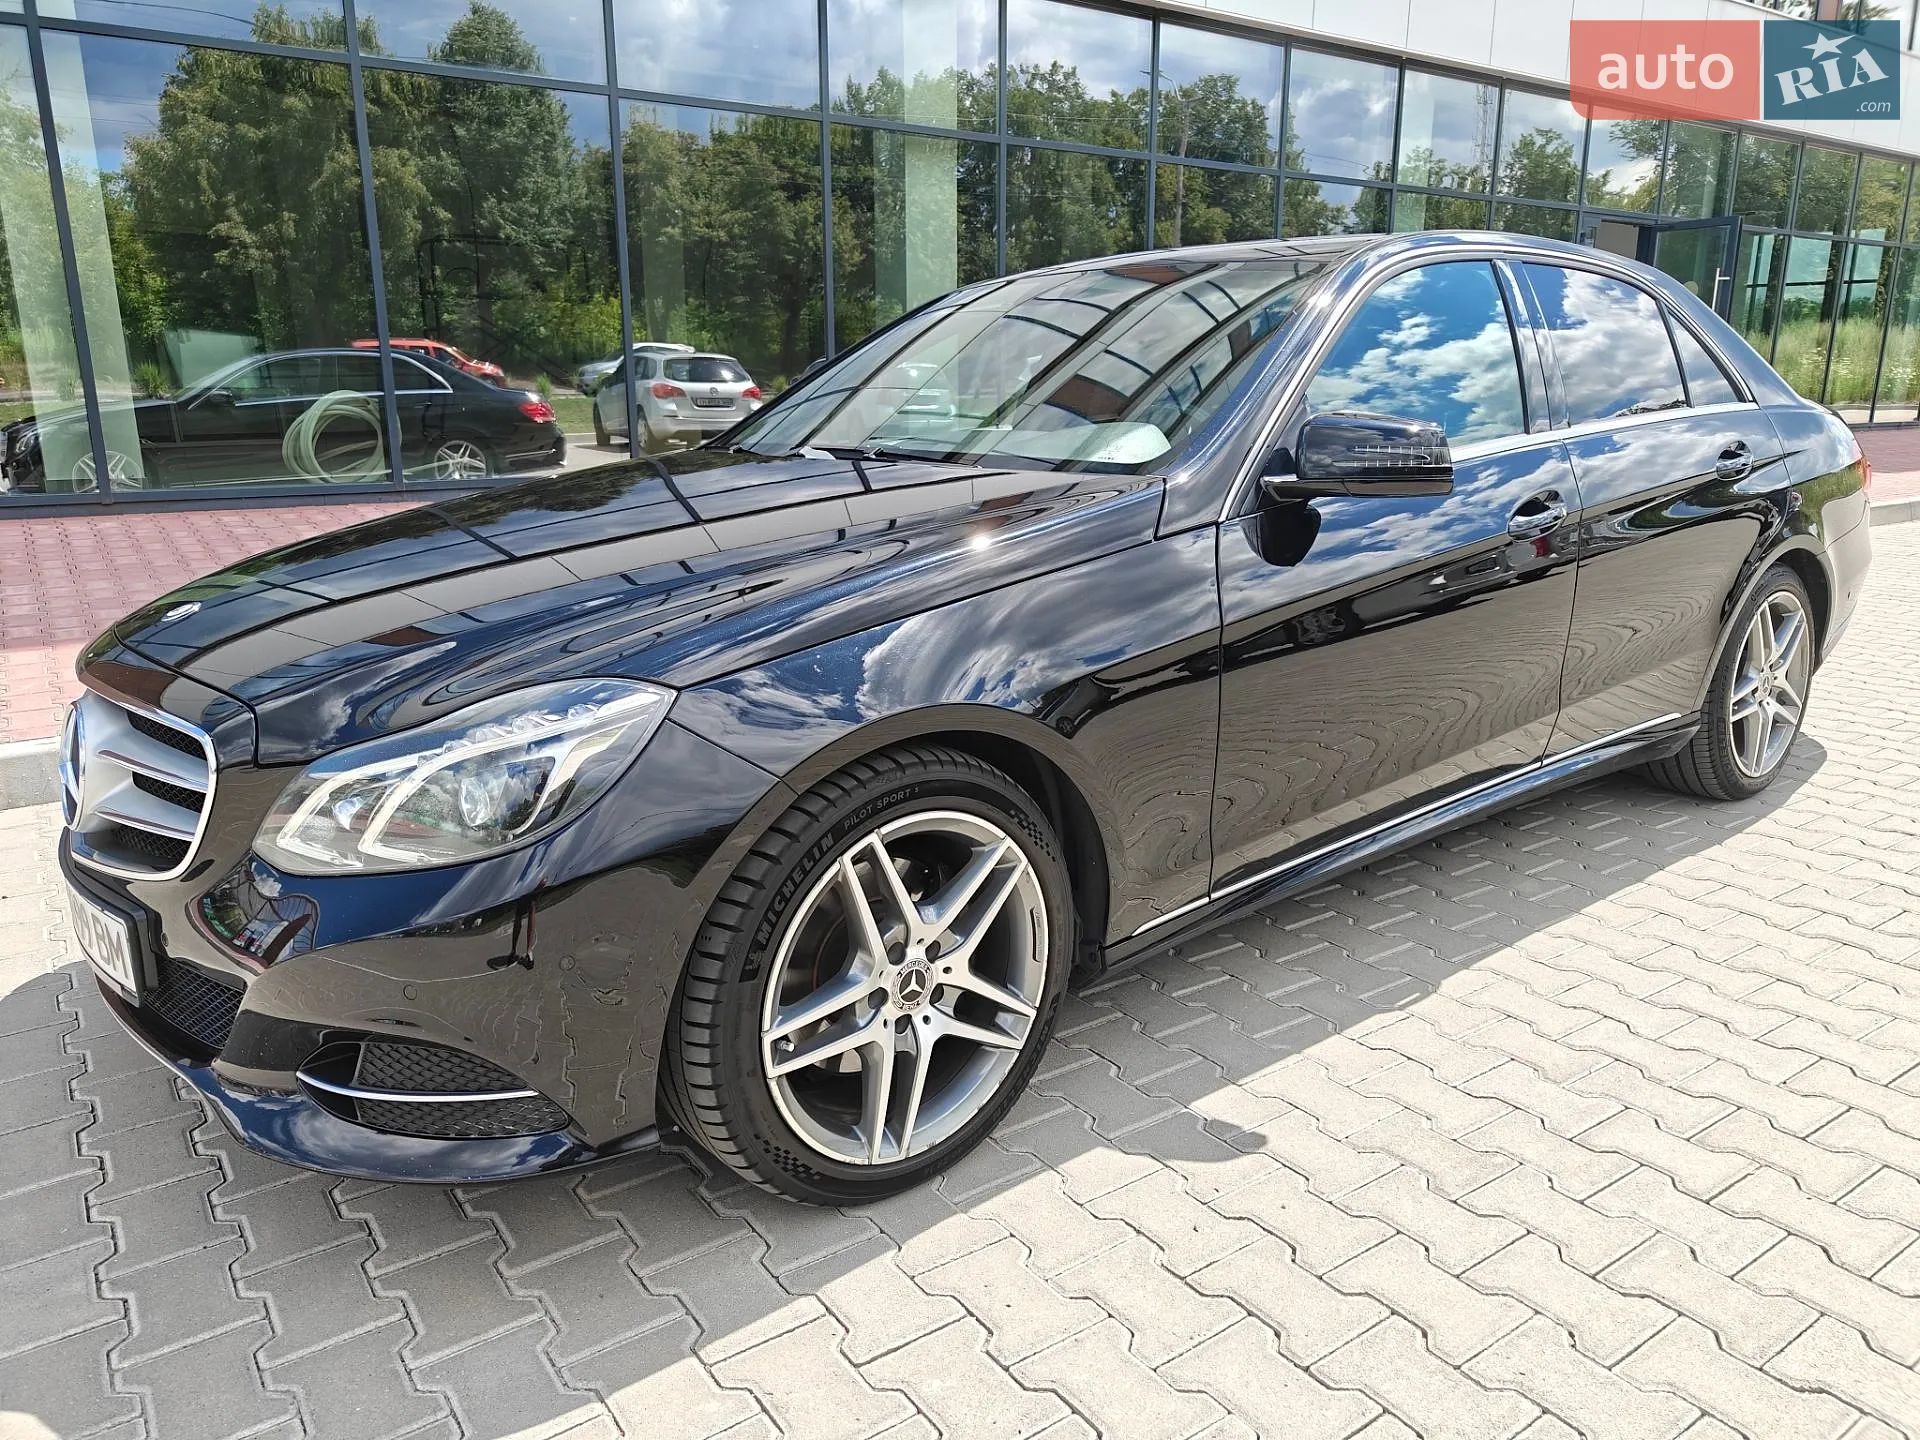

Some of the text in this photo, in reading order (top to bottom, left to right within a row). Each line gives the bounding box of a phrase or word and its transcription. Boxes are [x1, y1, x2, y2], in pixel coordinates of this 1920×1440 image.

[756, 832, 835, 945] MICHELIN
[844, 805, 873, 831] PILOT
[876, 788, 911, 809] SPORT
[91, 912, 129, 981] BM
